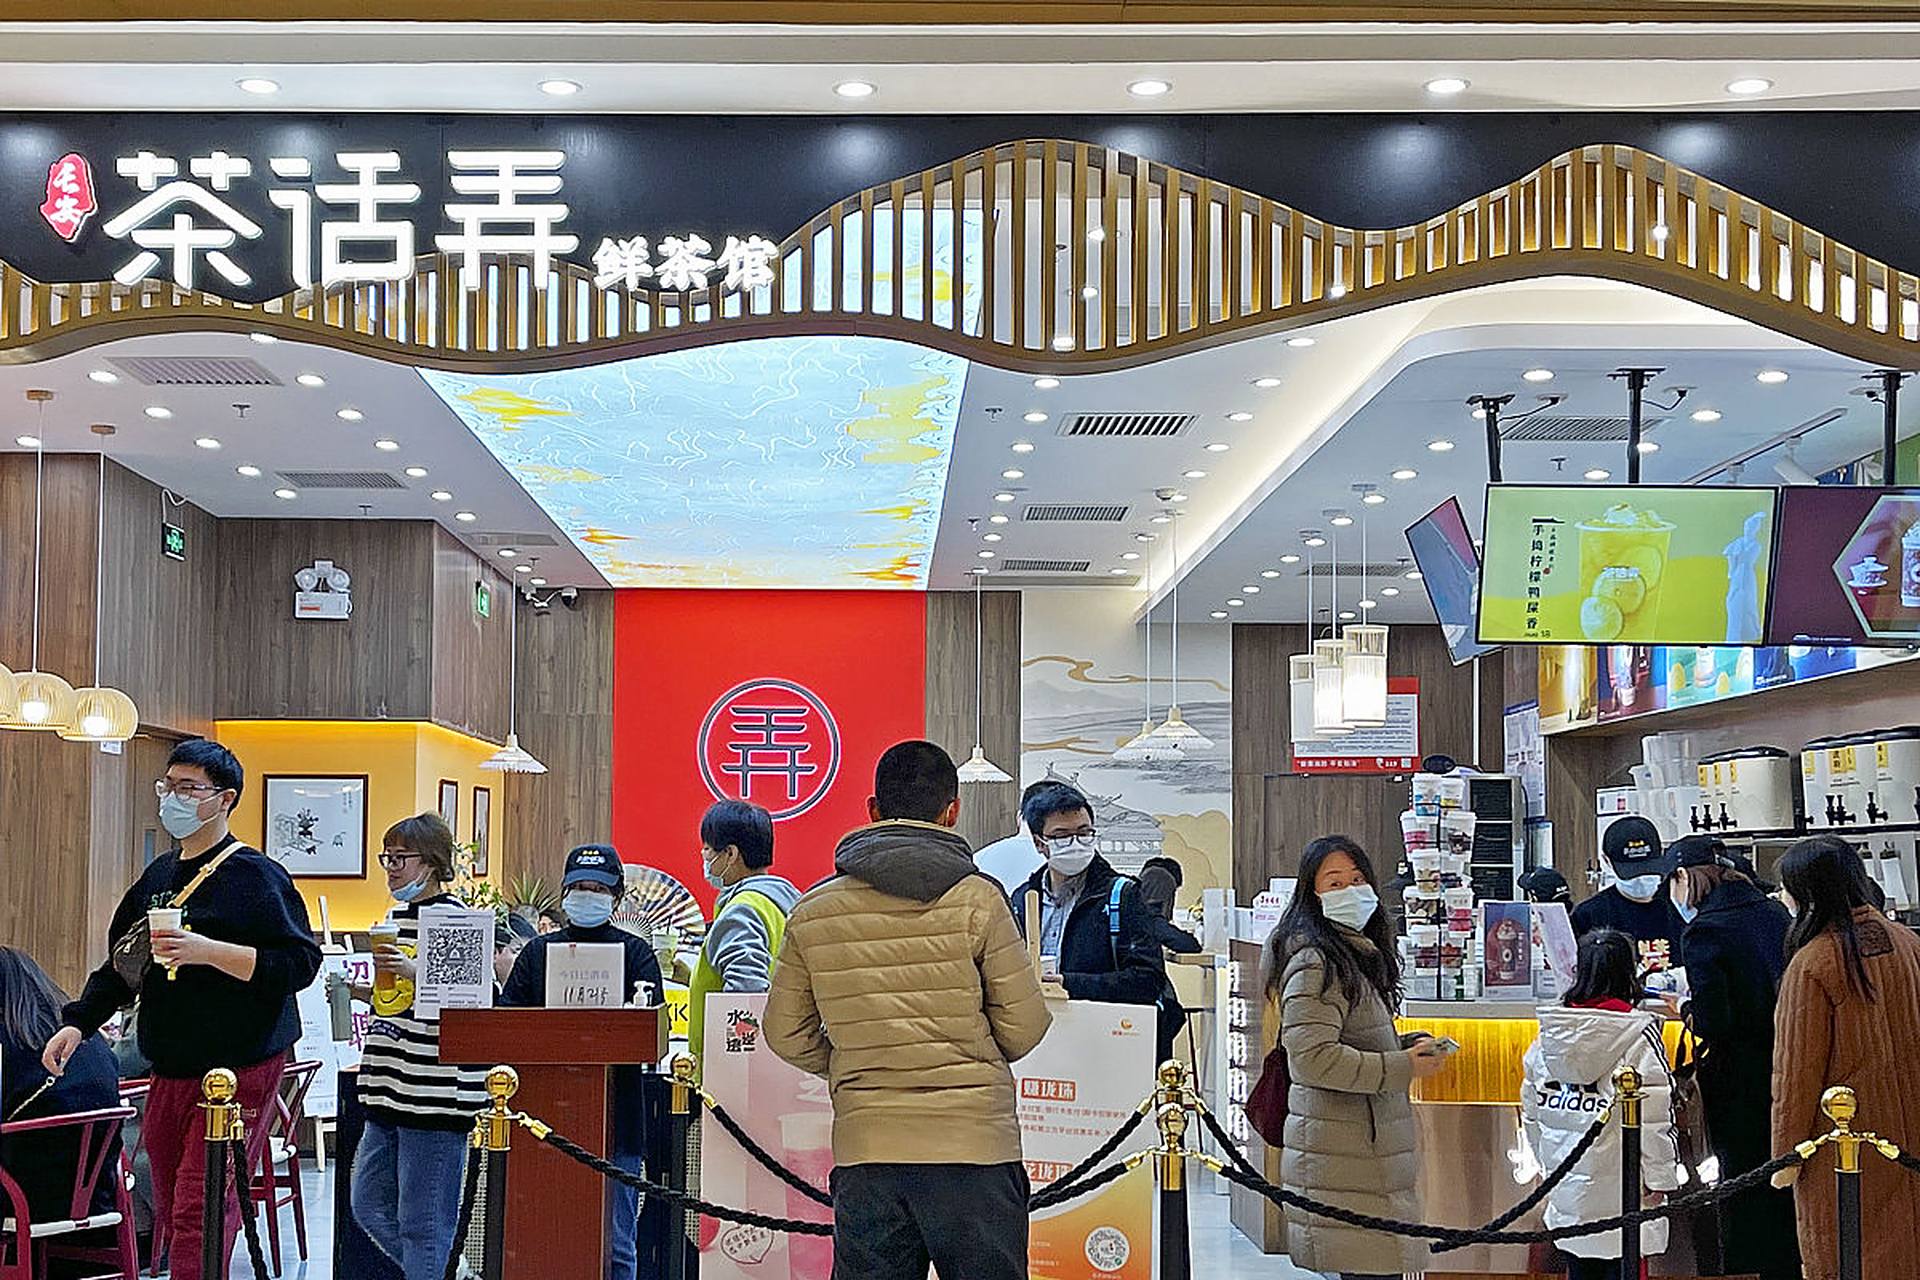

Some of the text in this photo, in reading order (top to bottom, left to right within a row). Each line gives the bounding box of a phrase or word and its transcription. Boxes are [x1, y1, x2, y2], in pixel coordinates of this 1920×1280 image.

[50, 162, 83, 225] 长安
[103, 150, 578, 291] 茶话弄
[591, 233, 779, 291] 鲜茶馆
[720, 705, 817, 799] 弄
[1537, 1091, 1608, 1113] adidas
